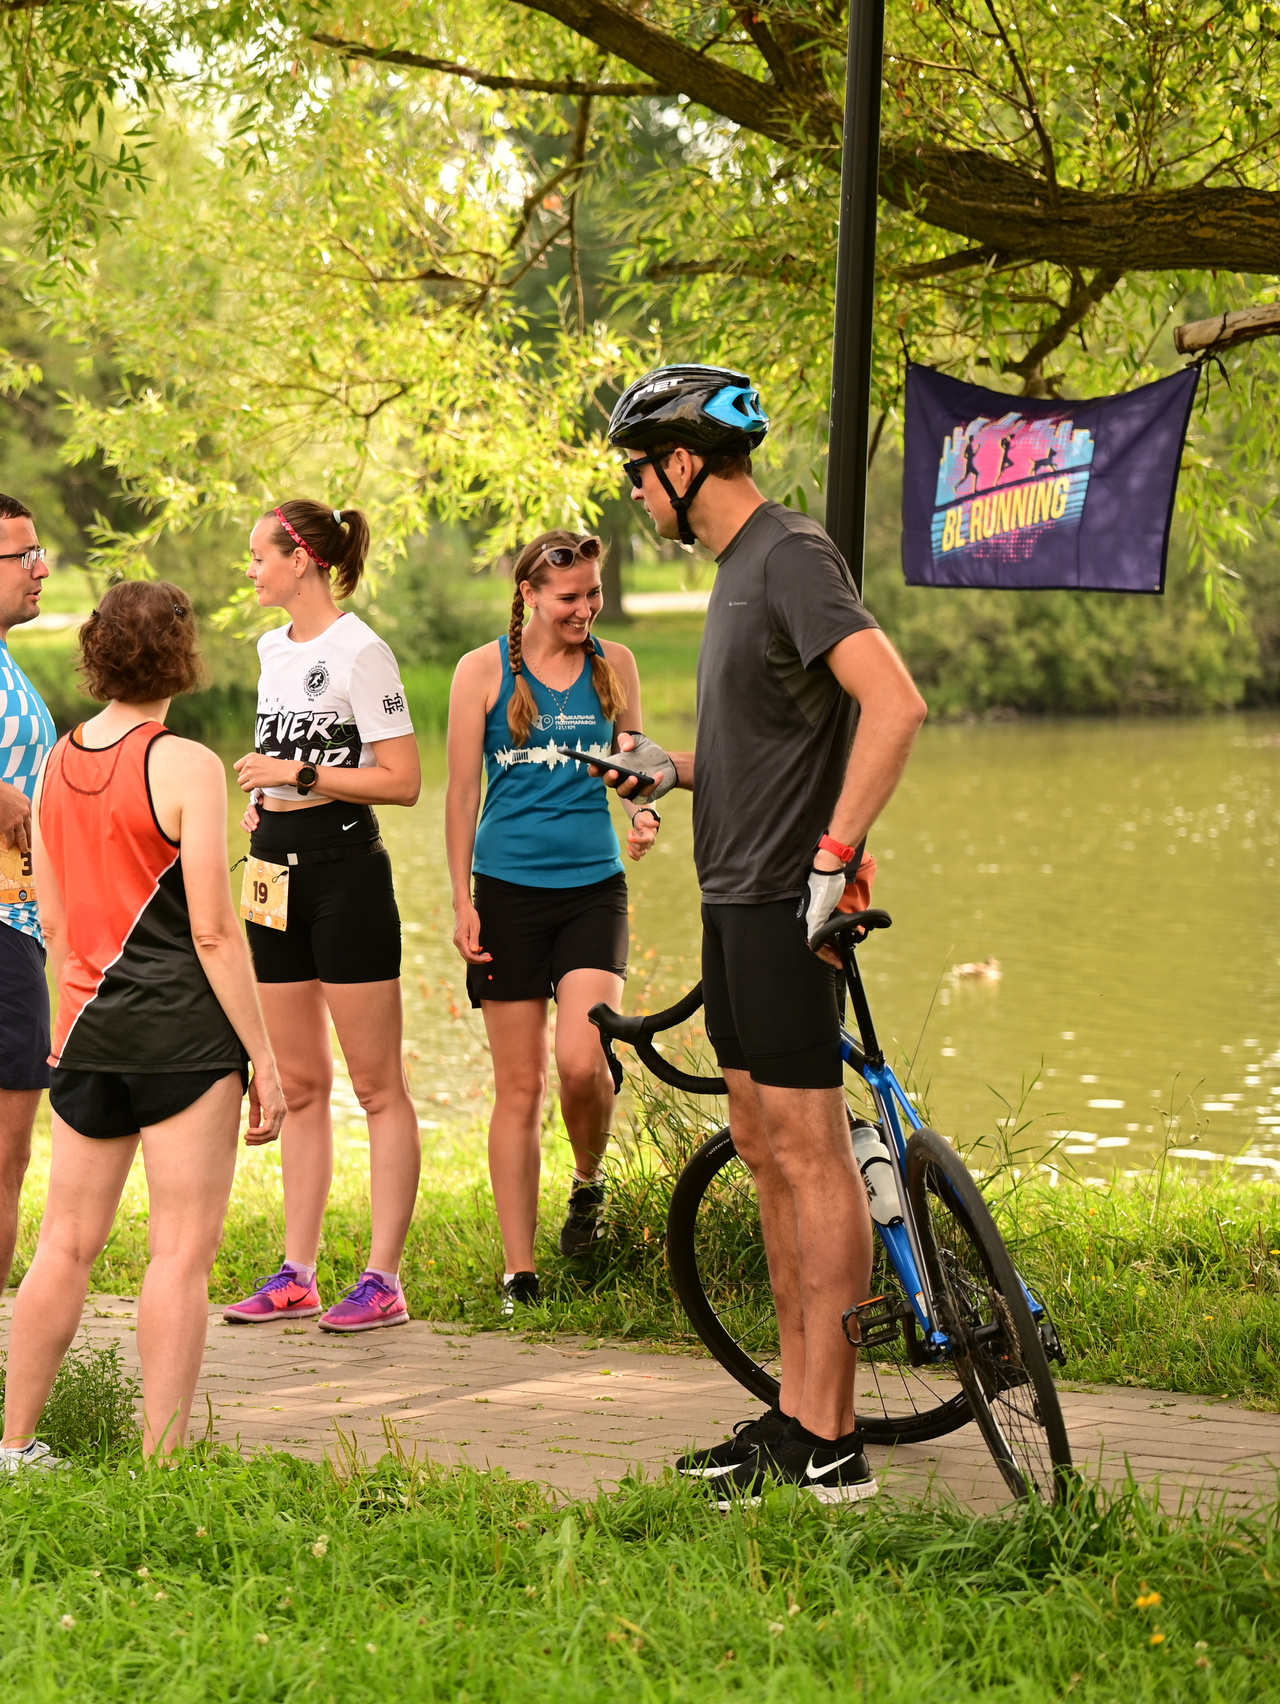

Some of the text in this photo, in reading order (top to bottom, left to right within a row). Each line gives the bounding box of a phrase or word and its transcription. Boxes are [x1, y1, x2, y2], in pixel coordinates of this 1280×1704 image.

[633, 378, 684, 401] MET
[970, 476, 1070, 543] RUNNING
[253, 880, 268, 904] 19
